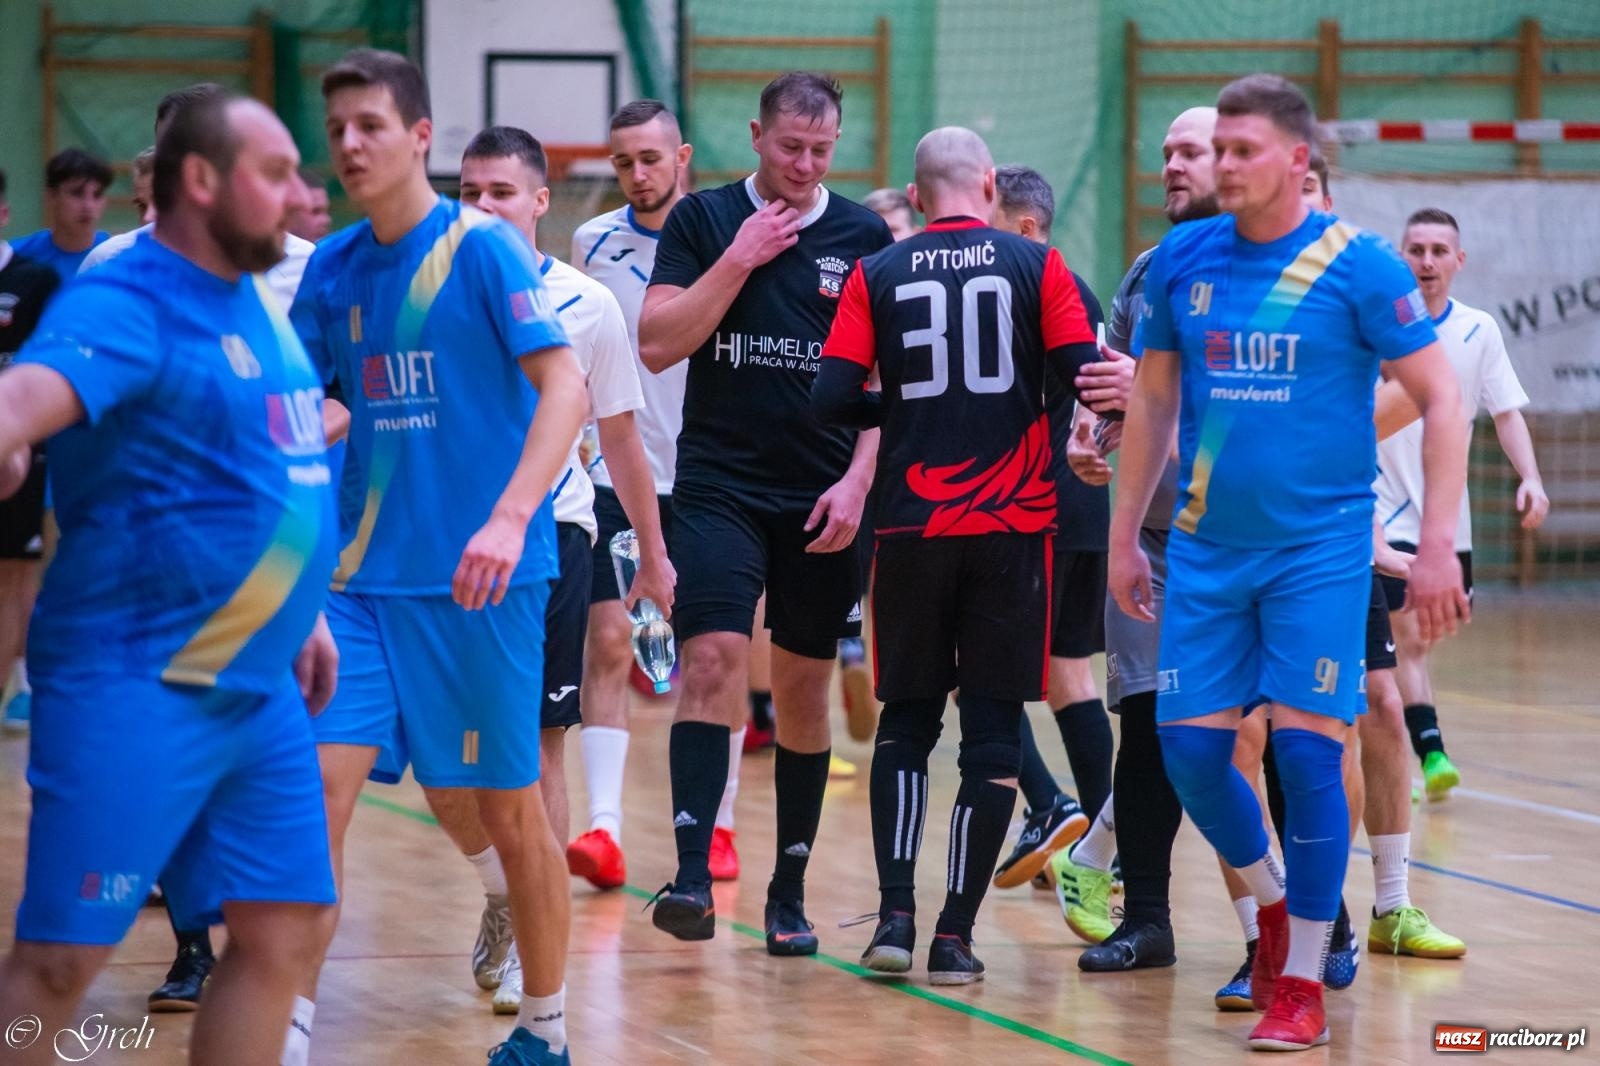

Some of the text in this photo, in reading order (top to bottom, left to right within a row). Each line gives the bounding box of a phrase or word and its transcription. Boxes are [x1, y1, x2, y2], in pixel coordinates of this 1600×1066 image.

[911, 240, 996, 273] PYTONIČ
[821, 277, 840, 292] KS
[1189, 281, 1214, 316] 91
[1500, 294, 1540, 337] W
[715, 331, 741, 369] HJ
[749, 335, 826, 361] HIMELJO
[895, 275, 1015, 400] 30
[1235, 331, 1301, 372] LOFT
[749, 355, 783, 368] PRACA
[786, 359, 797, 370] W
[1210, 385, 1291, 402] muventi
[1311, 657, 1340, 695] 91
